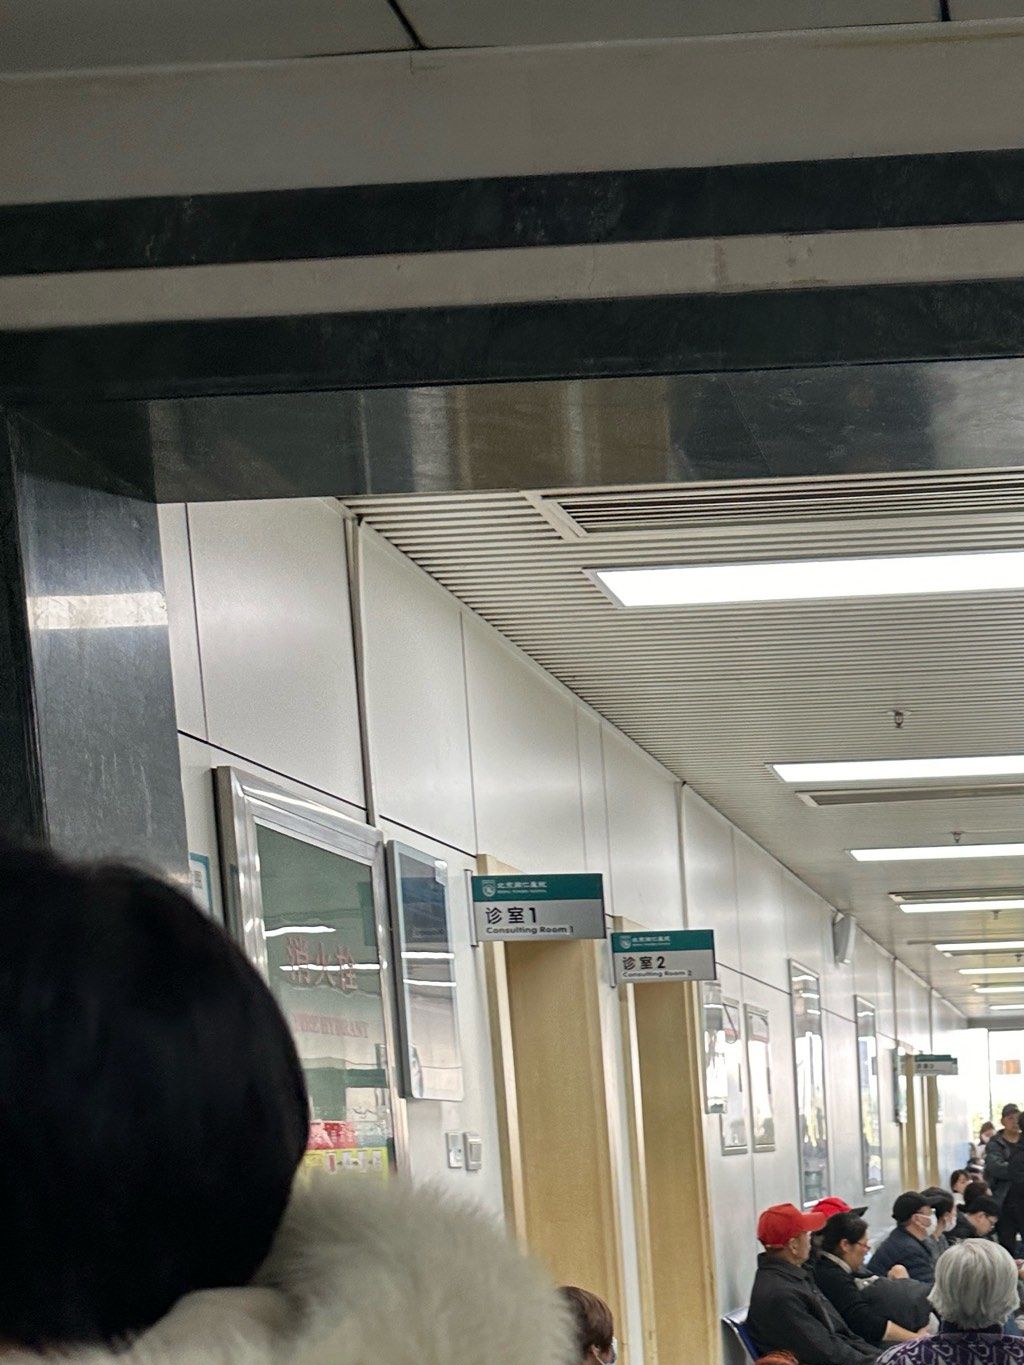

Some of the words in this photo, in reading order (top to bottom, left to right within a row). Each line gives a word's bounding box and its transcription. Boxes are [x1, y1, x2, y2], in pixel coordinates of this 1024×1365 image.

[485, 907, 537, 924] 诊室1
[486, 926, 537, 934] Consulting
[622, 956, 666, 970] 诊室2
